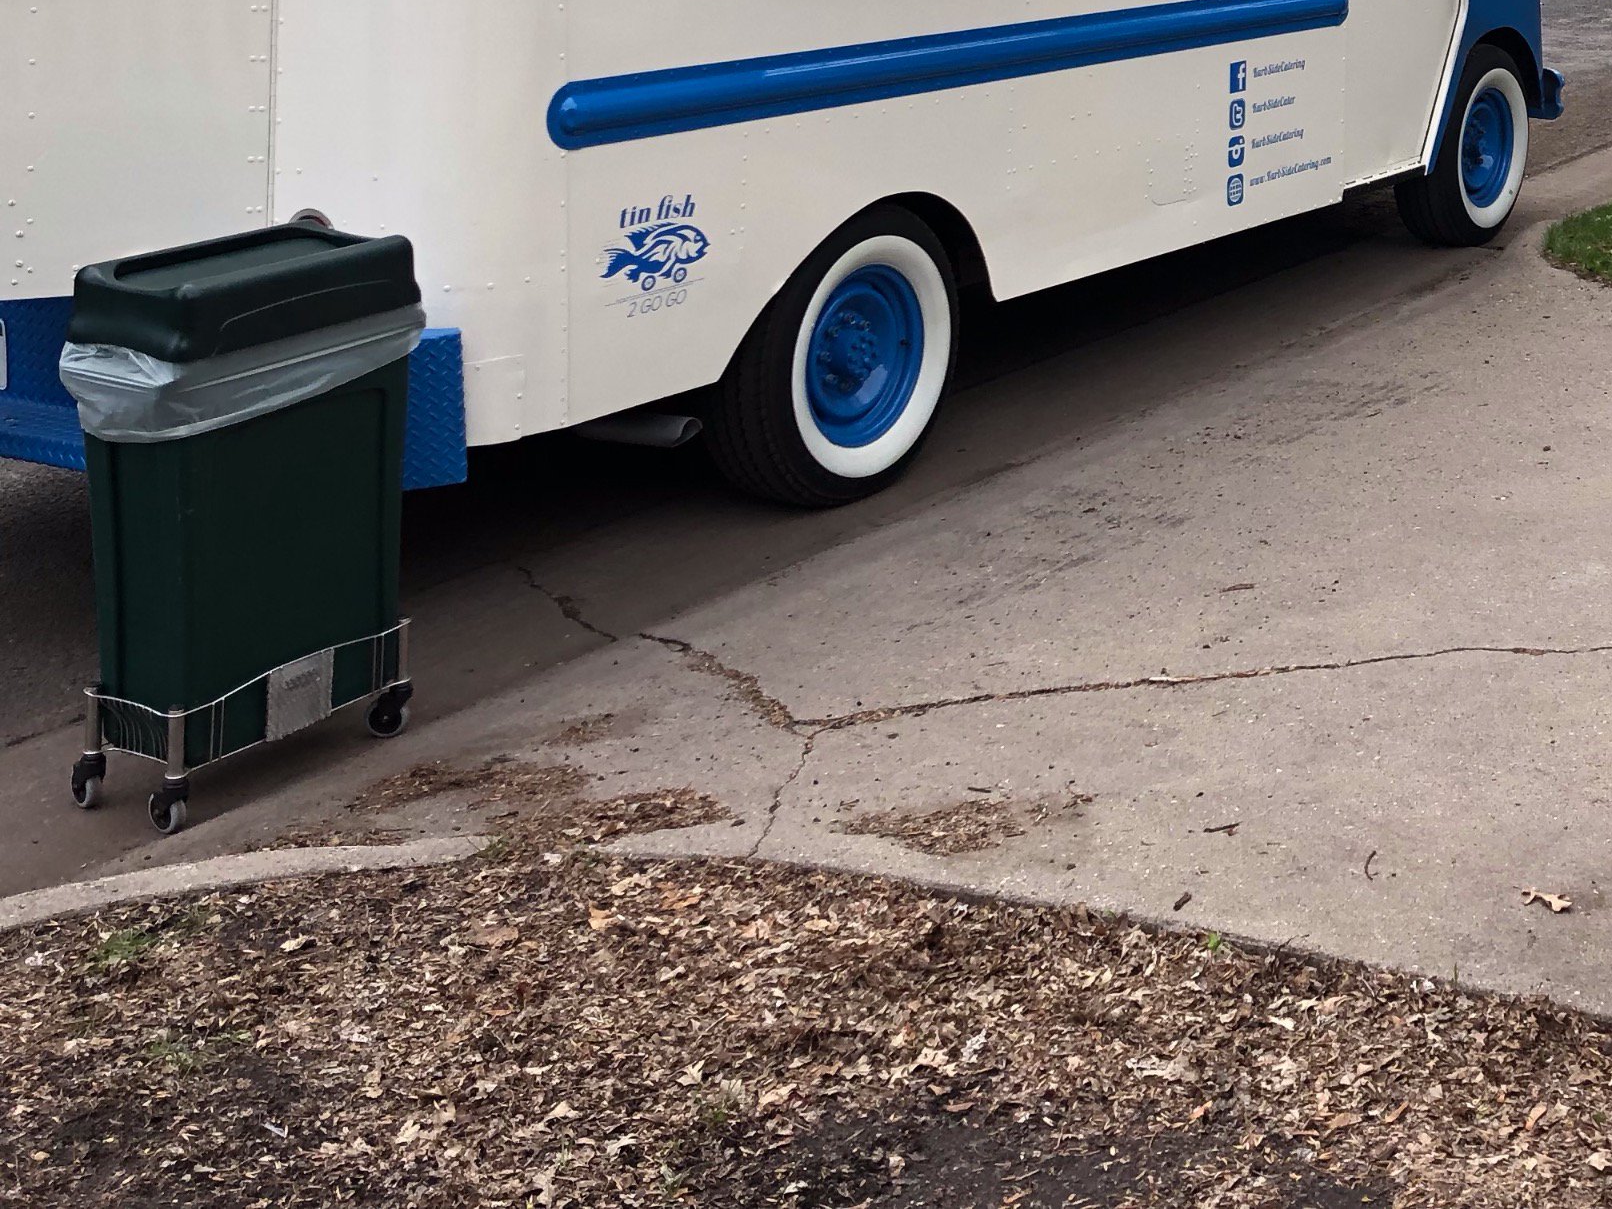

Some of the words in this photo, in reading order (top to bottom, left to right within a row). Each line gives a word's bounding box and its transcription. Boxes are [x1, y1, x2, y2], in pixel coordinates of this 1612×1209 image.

[619, 206, 651, 228] tin
[656, 194, 696, 220] fish
[626, 301, 638, 318] 2
[640, 295, 663, 314] GO
[666, 288, 688, 308] GO
